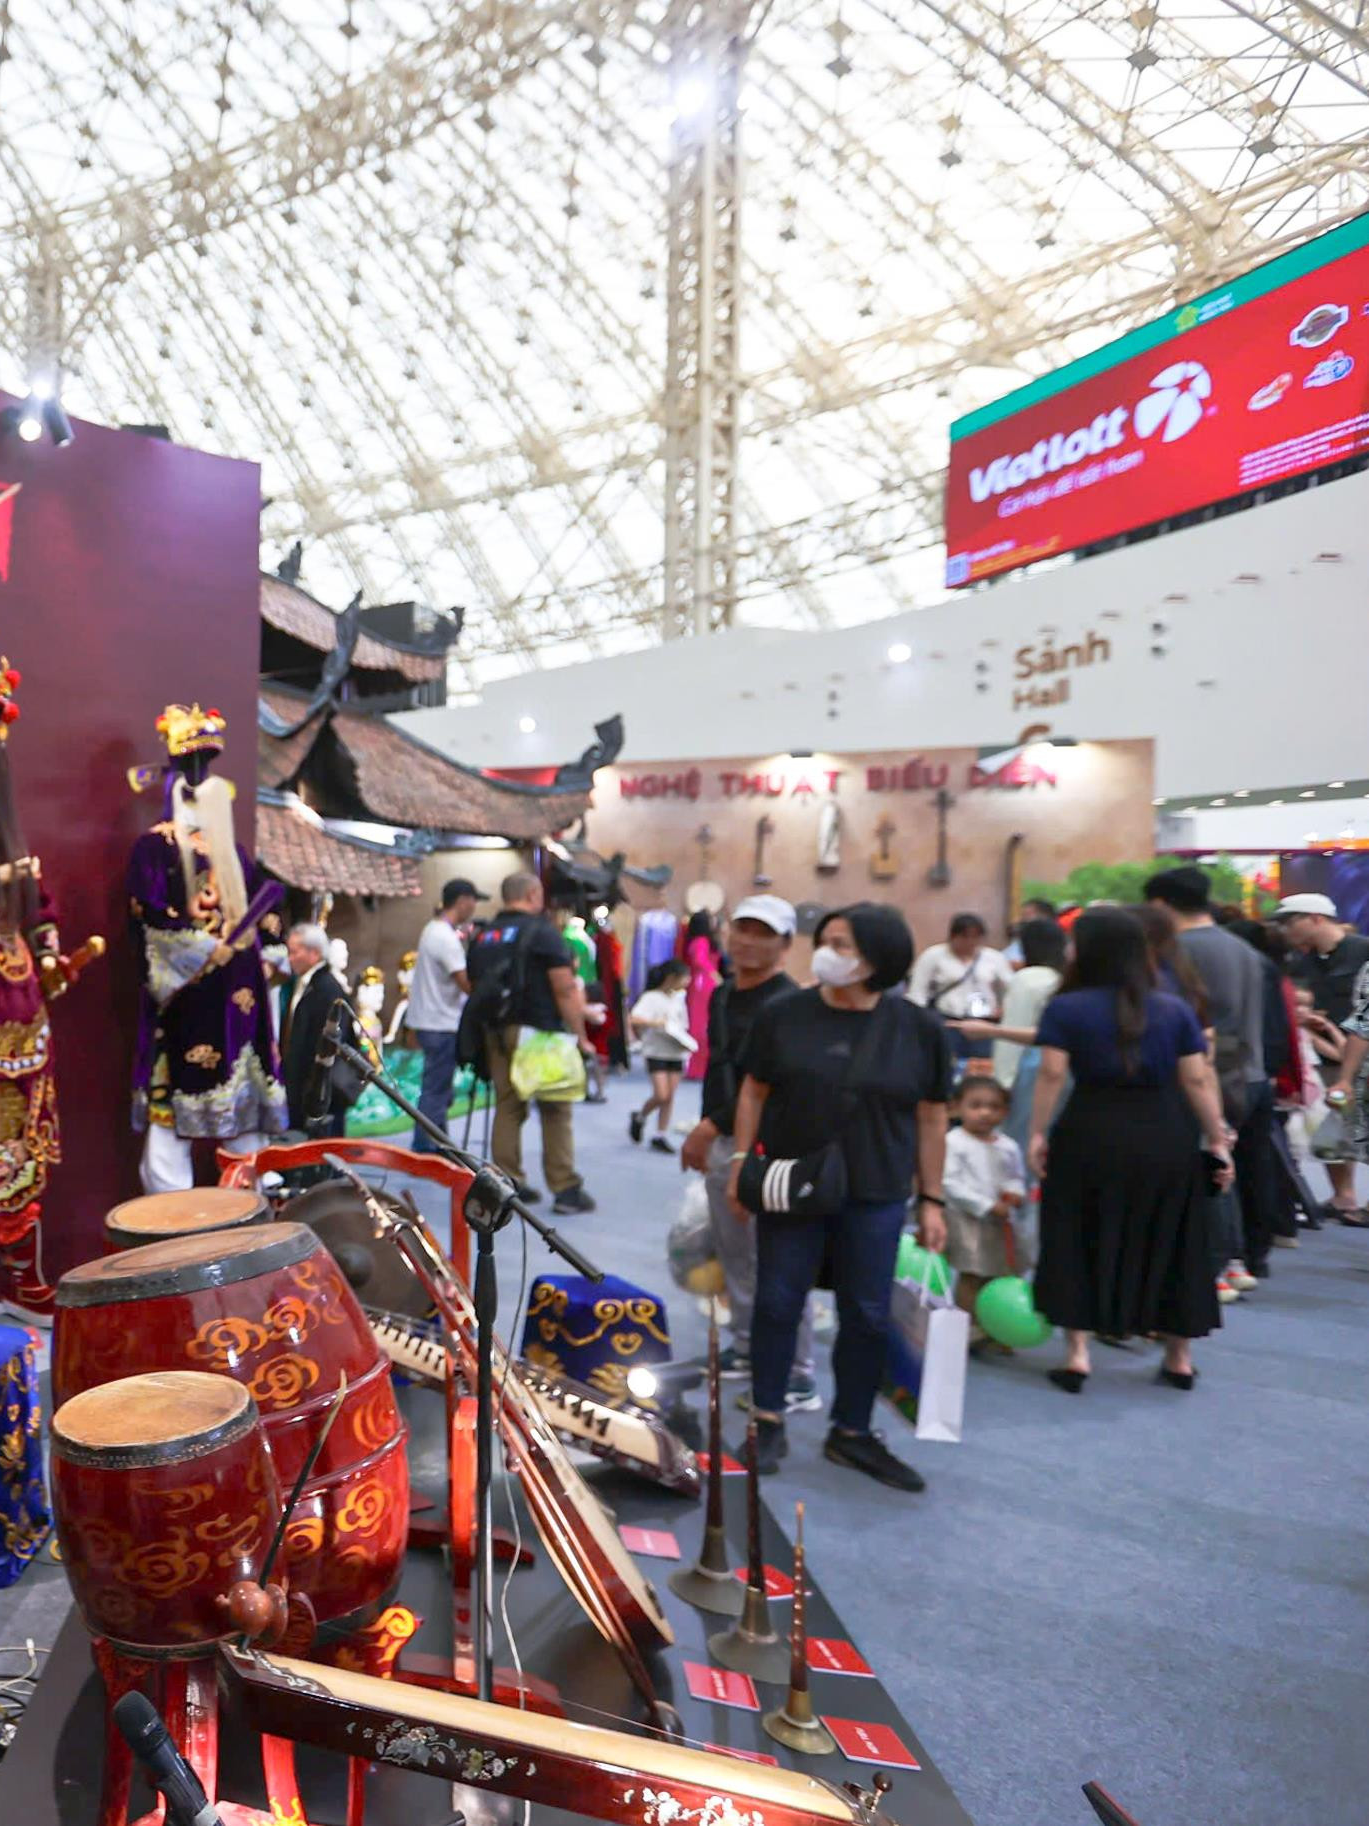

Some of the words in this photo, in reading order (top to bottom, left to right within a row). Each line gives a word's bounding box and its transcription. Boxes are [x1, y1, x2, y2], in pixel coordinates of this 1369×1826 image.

[968, 405, 1129, 503] Vietlott
[1015, 629, 1111, 680] Sảnh
[1013, 678, 1070, 711] Hall
